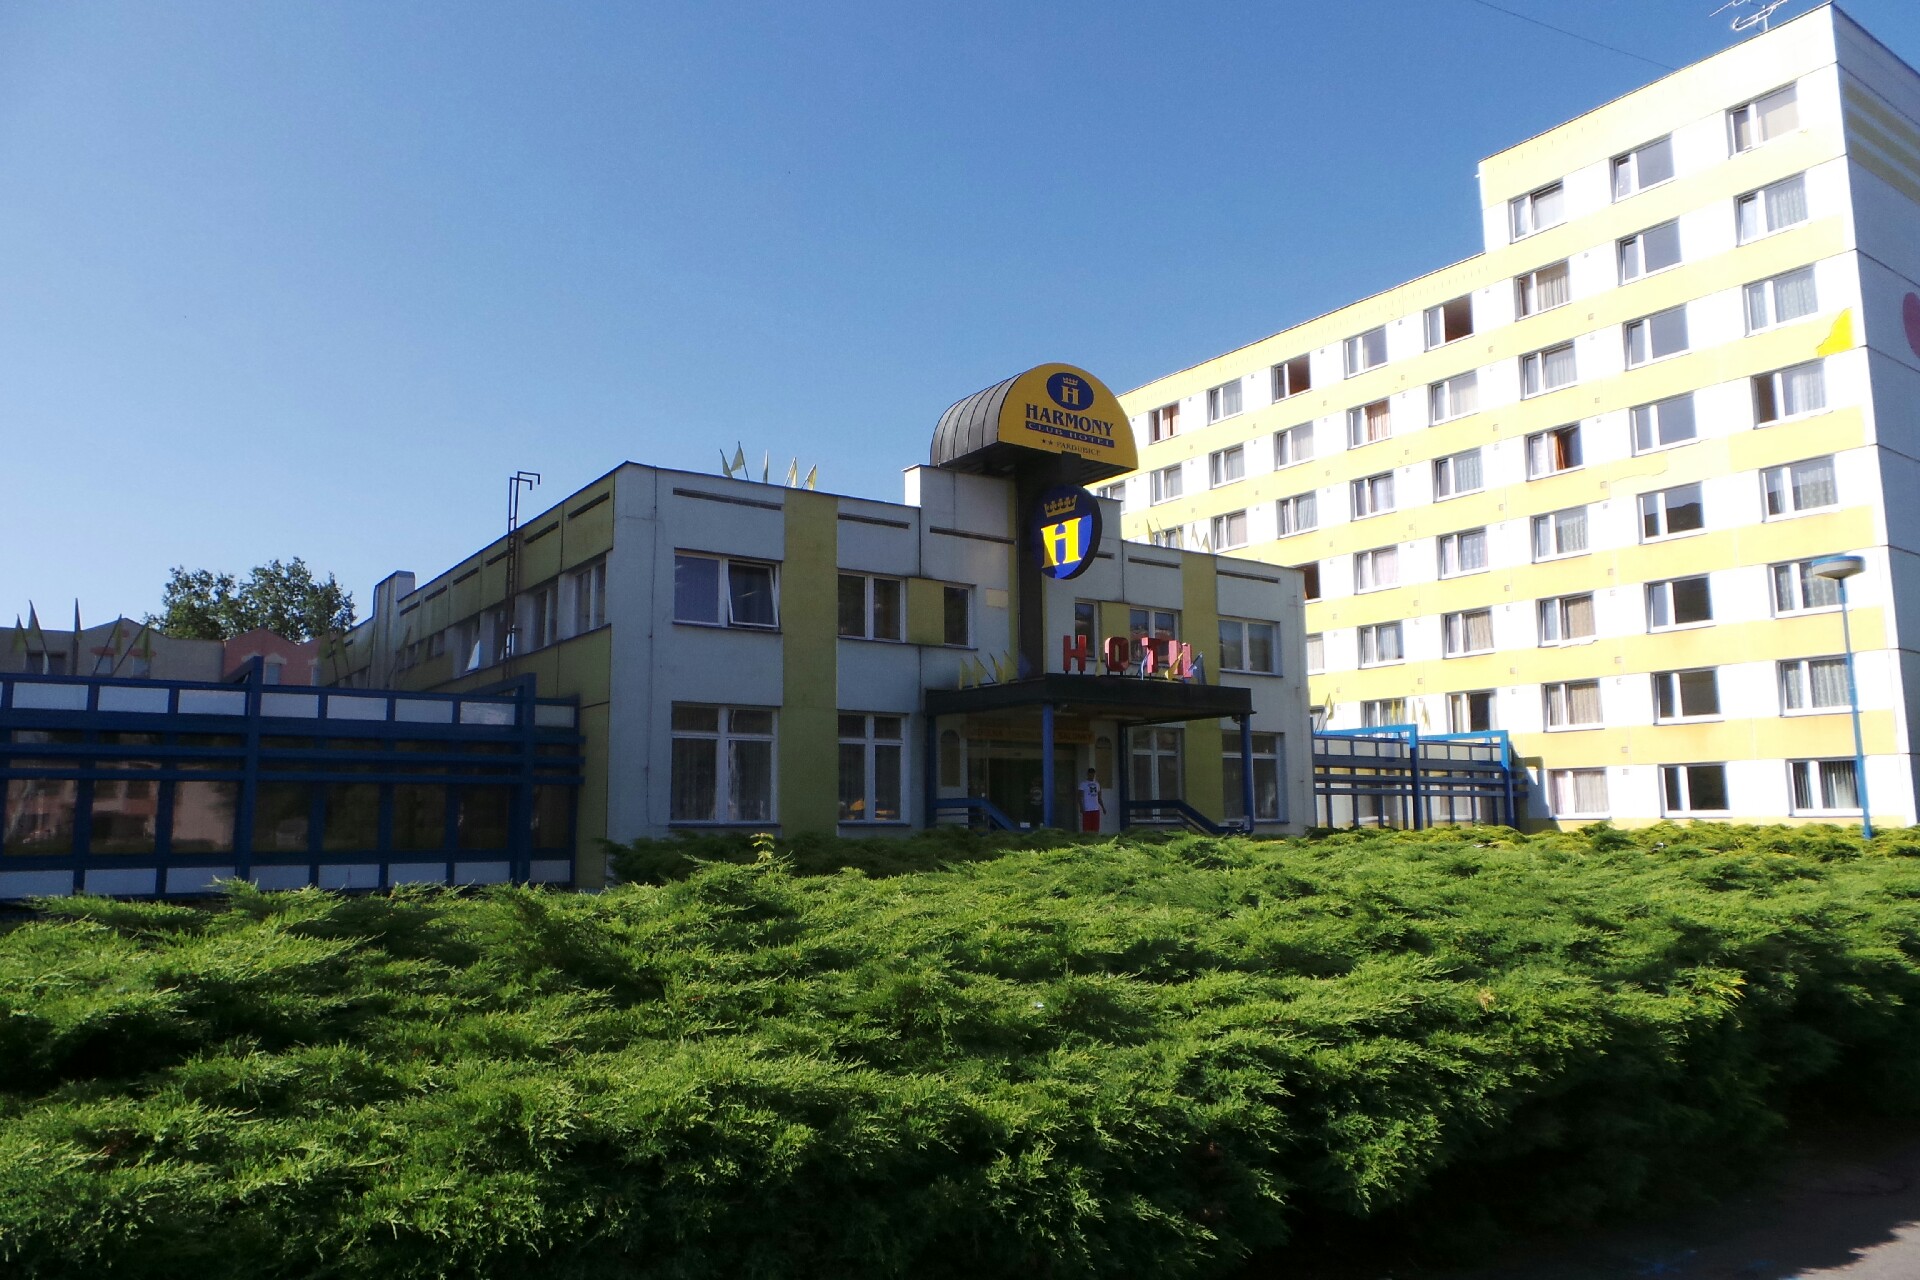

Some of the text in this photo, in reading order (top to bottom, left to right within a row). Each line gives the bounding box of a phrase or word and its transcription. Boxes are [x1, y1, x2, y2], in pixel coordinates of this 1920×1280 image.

[1061, 385, 1080, 406] H
[1025, 403, 1114, 437] HARMONY
[1028, 422, 1111, 447] CLUB HOTEL
[1040, 517, 1082, 569] H
